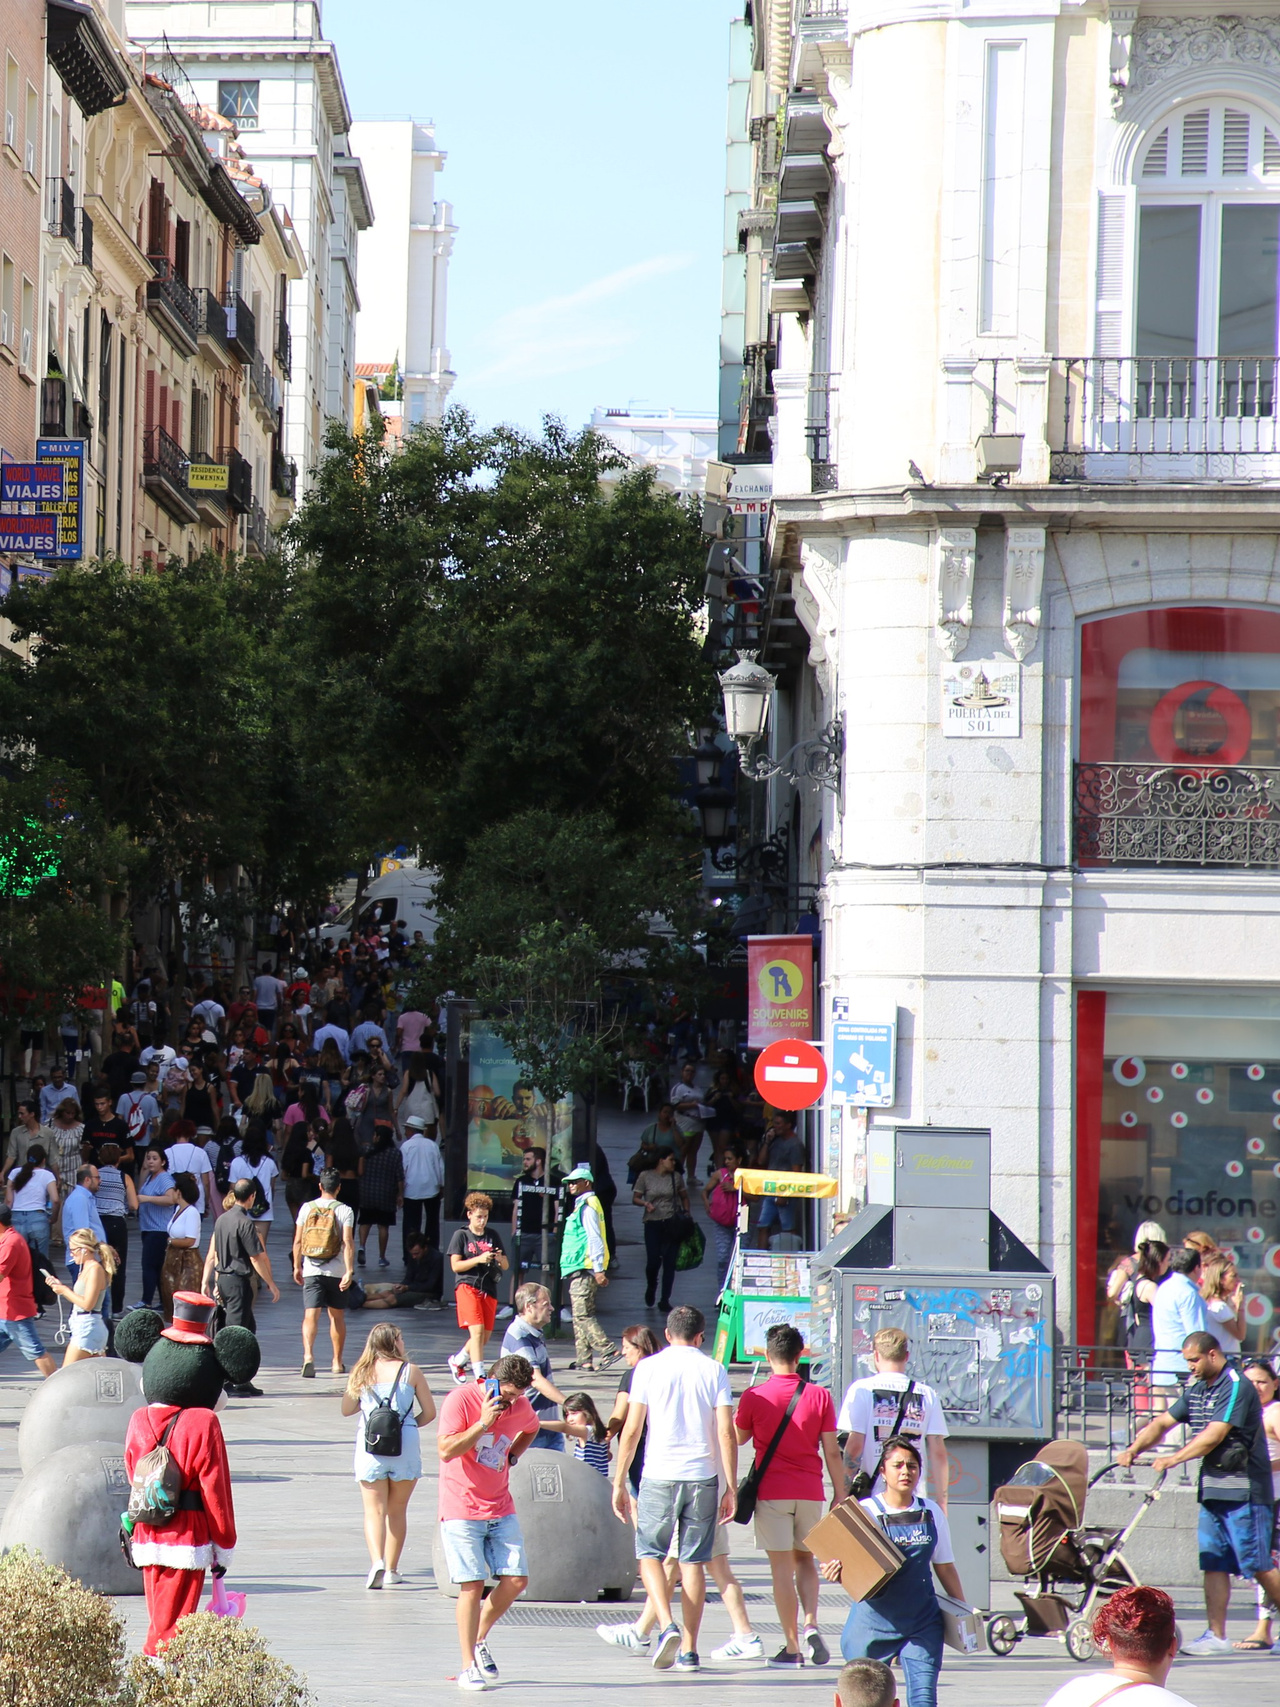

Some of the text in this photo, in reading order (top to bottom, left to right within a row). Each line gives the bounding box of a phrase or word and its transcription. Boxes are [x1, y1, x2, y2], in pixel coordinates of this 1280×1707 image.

[5, 467, 61, 482] WORLD TRAVEL
[191, 466, 227, 474] RESIDENCIA
[5, 484, 61, 499] VIAJES
[734, 484, 773, 493] EXCHANGE
[67, 501, 78, 513] DE
[948, 707, 1014, 719] PUERTA DEL
[967, 720, 995, 732] SOL
[752, 1008, 809, 1020] SOUVENIRS
[778, 1182, 813, 1194] ONCE
[1123, 1189, 1277, 1219] vodafone
[753, 1308, 793, 1328] Verano
[893, 1534, 933, 1544] APLAUSO
